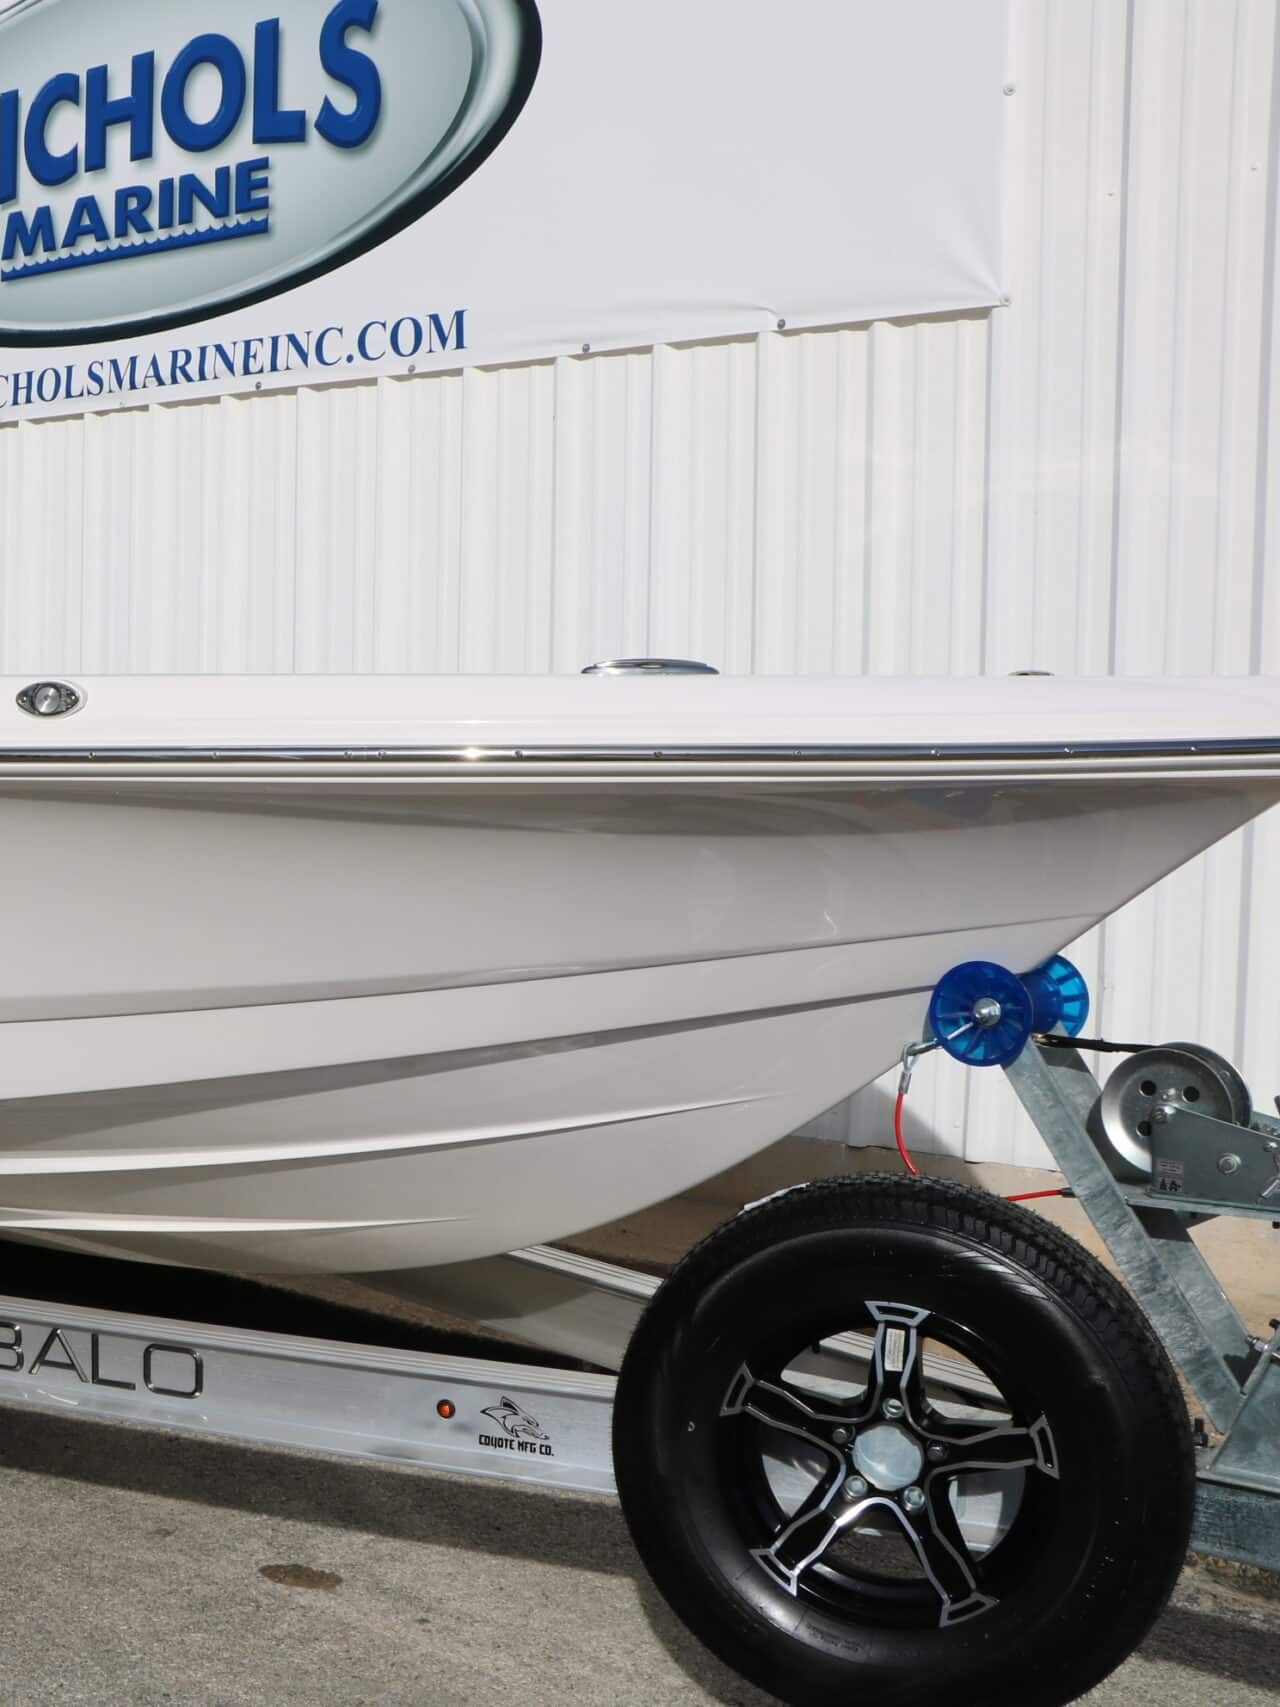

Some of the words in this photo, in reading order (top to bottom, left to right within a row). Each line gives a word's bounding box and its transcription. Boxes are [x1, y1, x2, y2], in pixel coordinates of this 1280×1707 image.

[2, 157, 269, 260] MARINE
[479, 1434, 515, 1450] COYOTE
[517, 1440, 536, 1453] MFG
[539, 1444, 554, 1456] CO.
